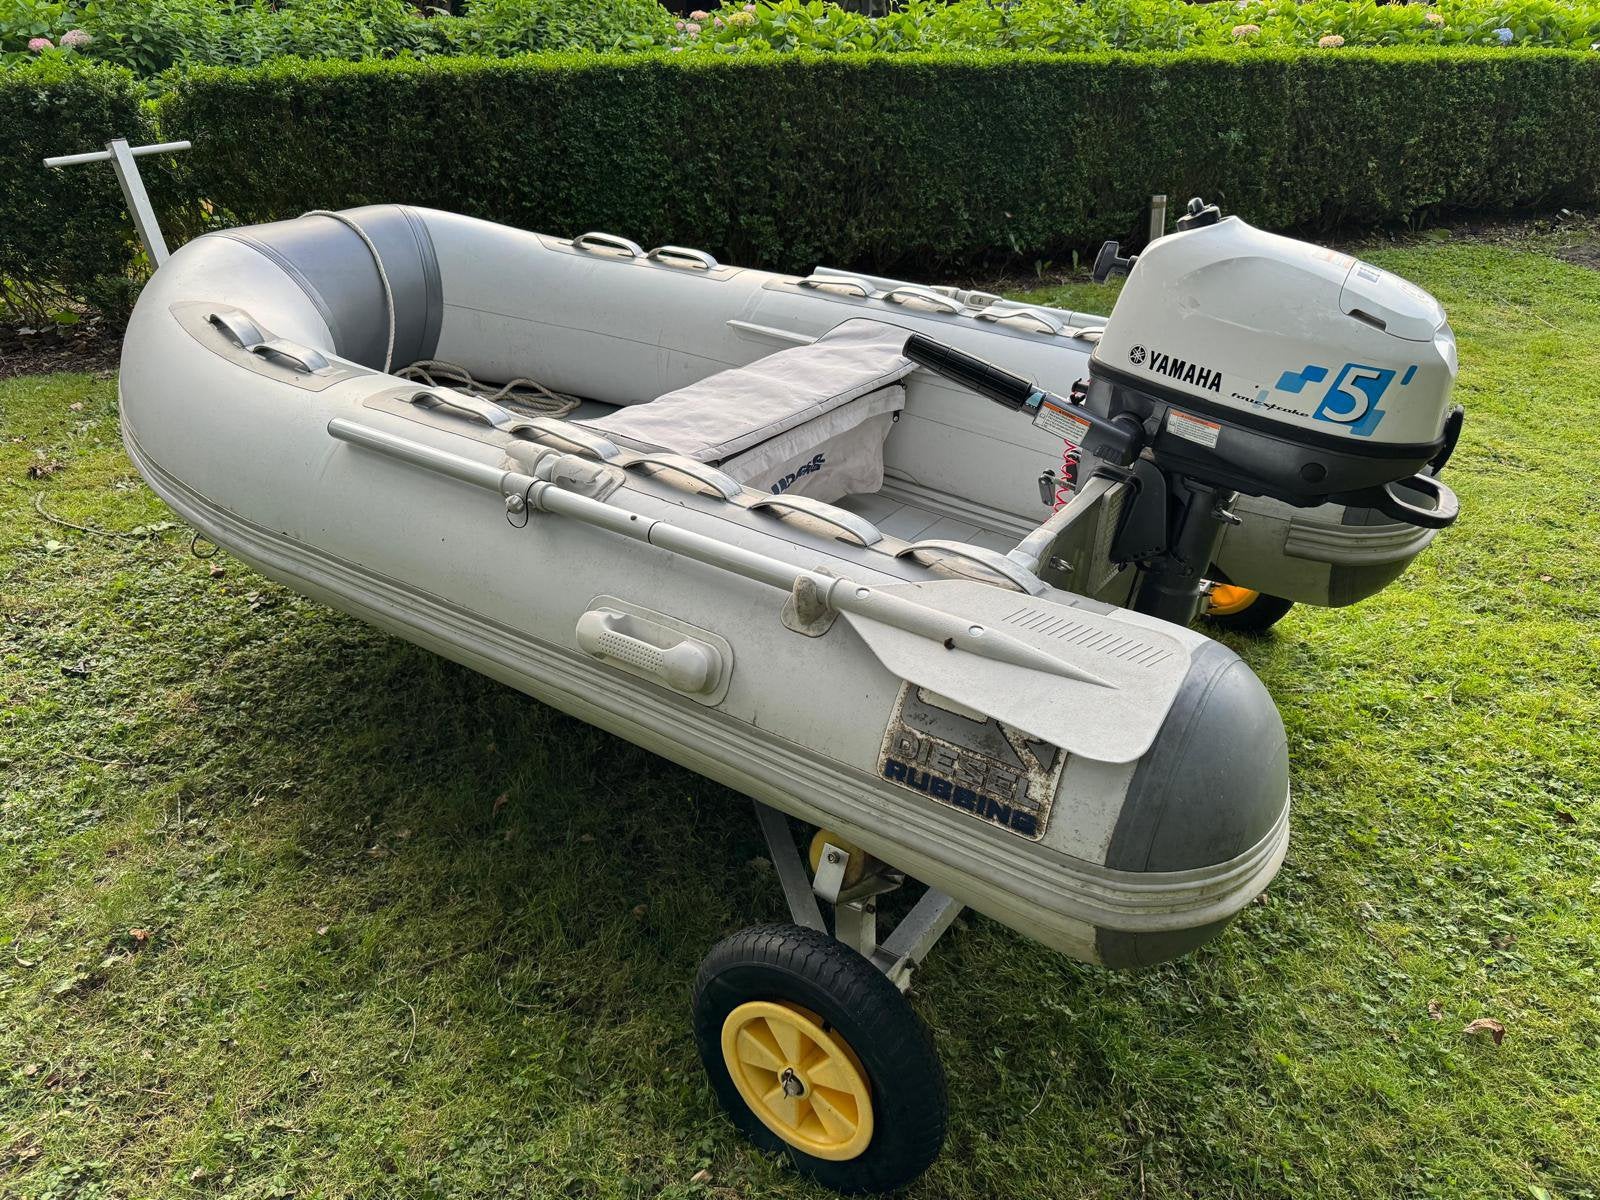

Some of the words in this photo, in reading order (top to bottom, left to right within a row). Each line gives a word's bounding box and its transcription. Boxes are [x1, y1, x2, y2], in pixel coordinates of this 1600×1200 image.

[1148, 350, 1222, 393] YAMAHA
[1321, 366, 1381, 422] 5
[883, 757, 1039, 837] RUBBING
[892, 732, 1041, 811] DIESEL
